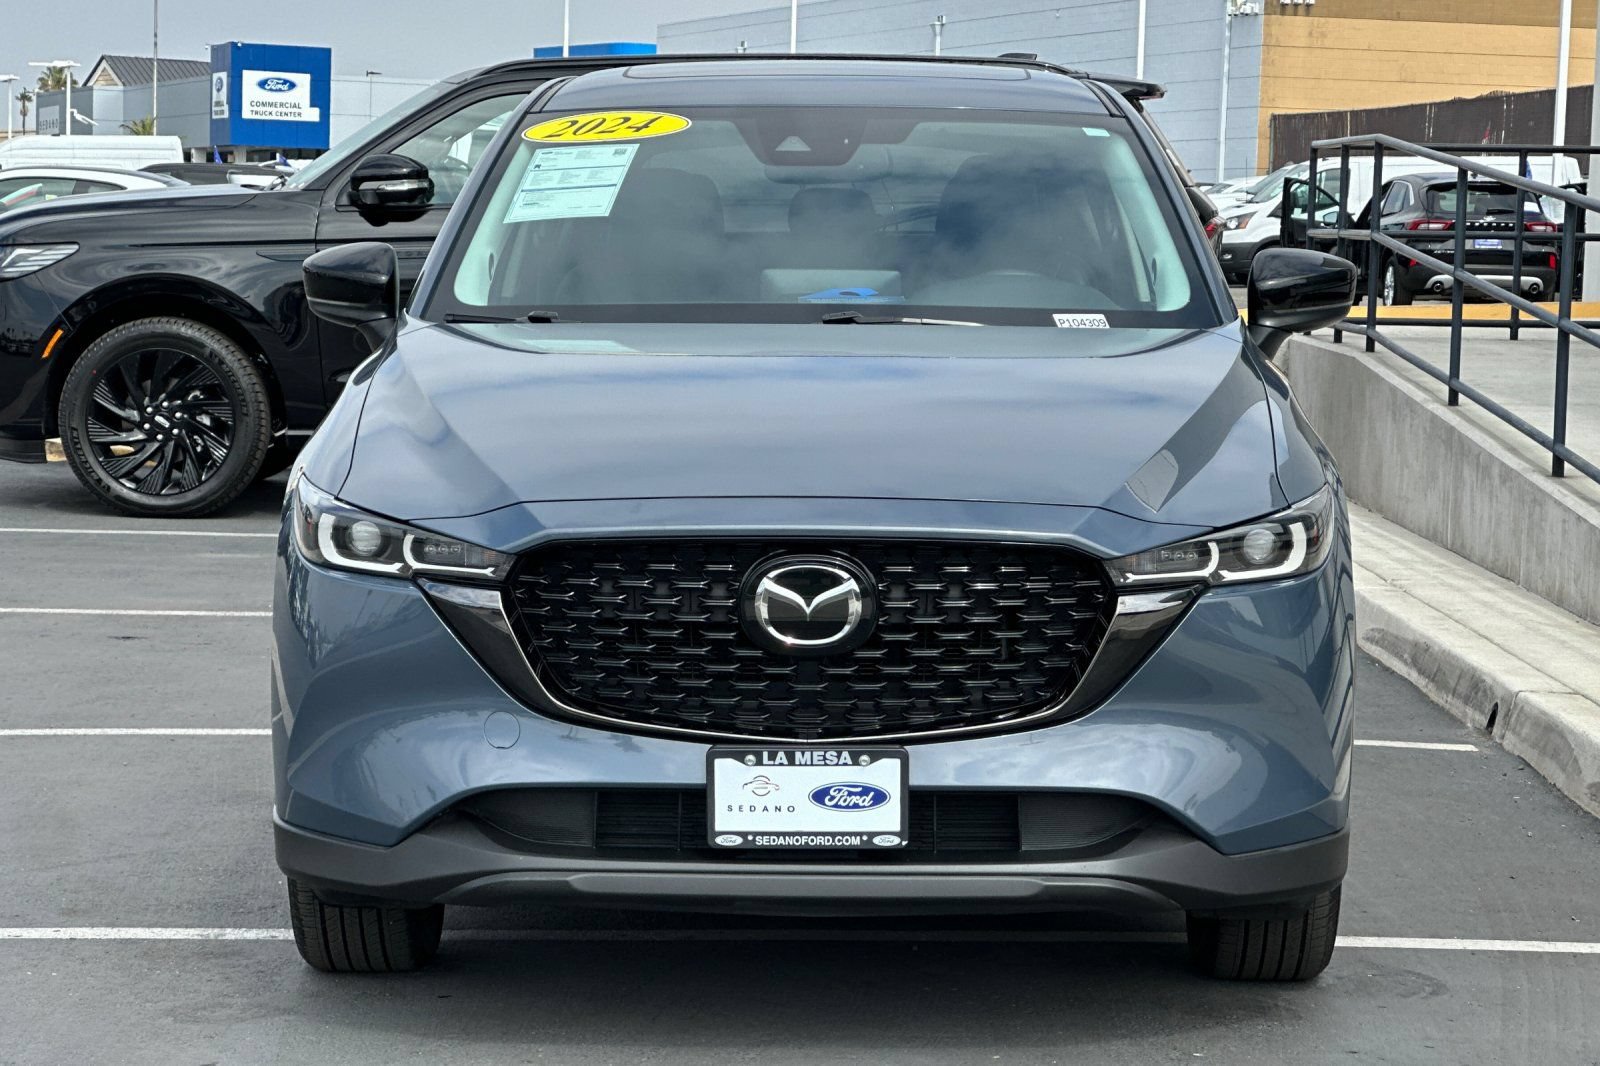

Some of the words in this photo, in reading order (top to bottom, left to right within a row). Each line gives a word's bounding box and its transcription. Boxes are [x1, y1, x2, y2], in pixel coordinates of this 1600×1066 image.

[264, 78, 291, 91] Ford
[250, 100, 302, 109] COMMERCIAL
[275, 110, 302, 118] CENTER
[541, 115, 664, 138] 2024
[1058, 318, 1107, 327] P104309
[762, 751, 789, 765] LA
[794, 751, 853, 765] MESA
[822, 785, 876, 808] Ford
[727, 804, 795, 813] SEDANO
[719, 836, 739, 845] Ford
[755, 836, 861, 846] SEDANOFORD.COM
[877, 836, 896, 845] Ford
